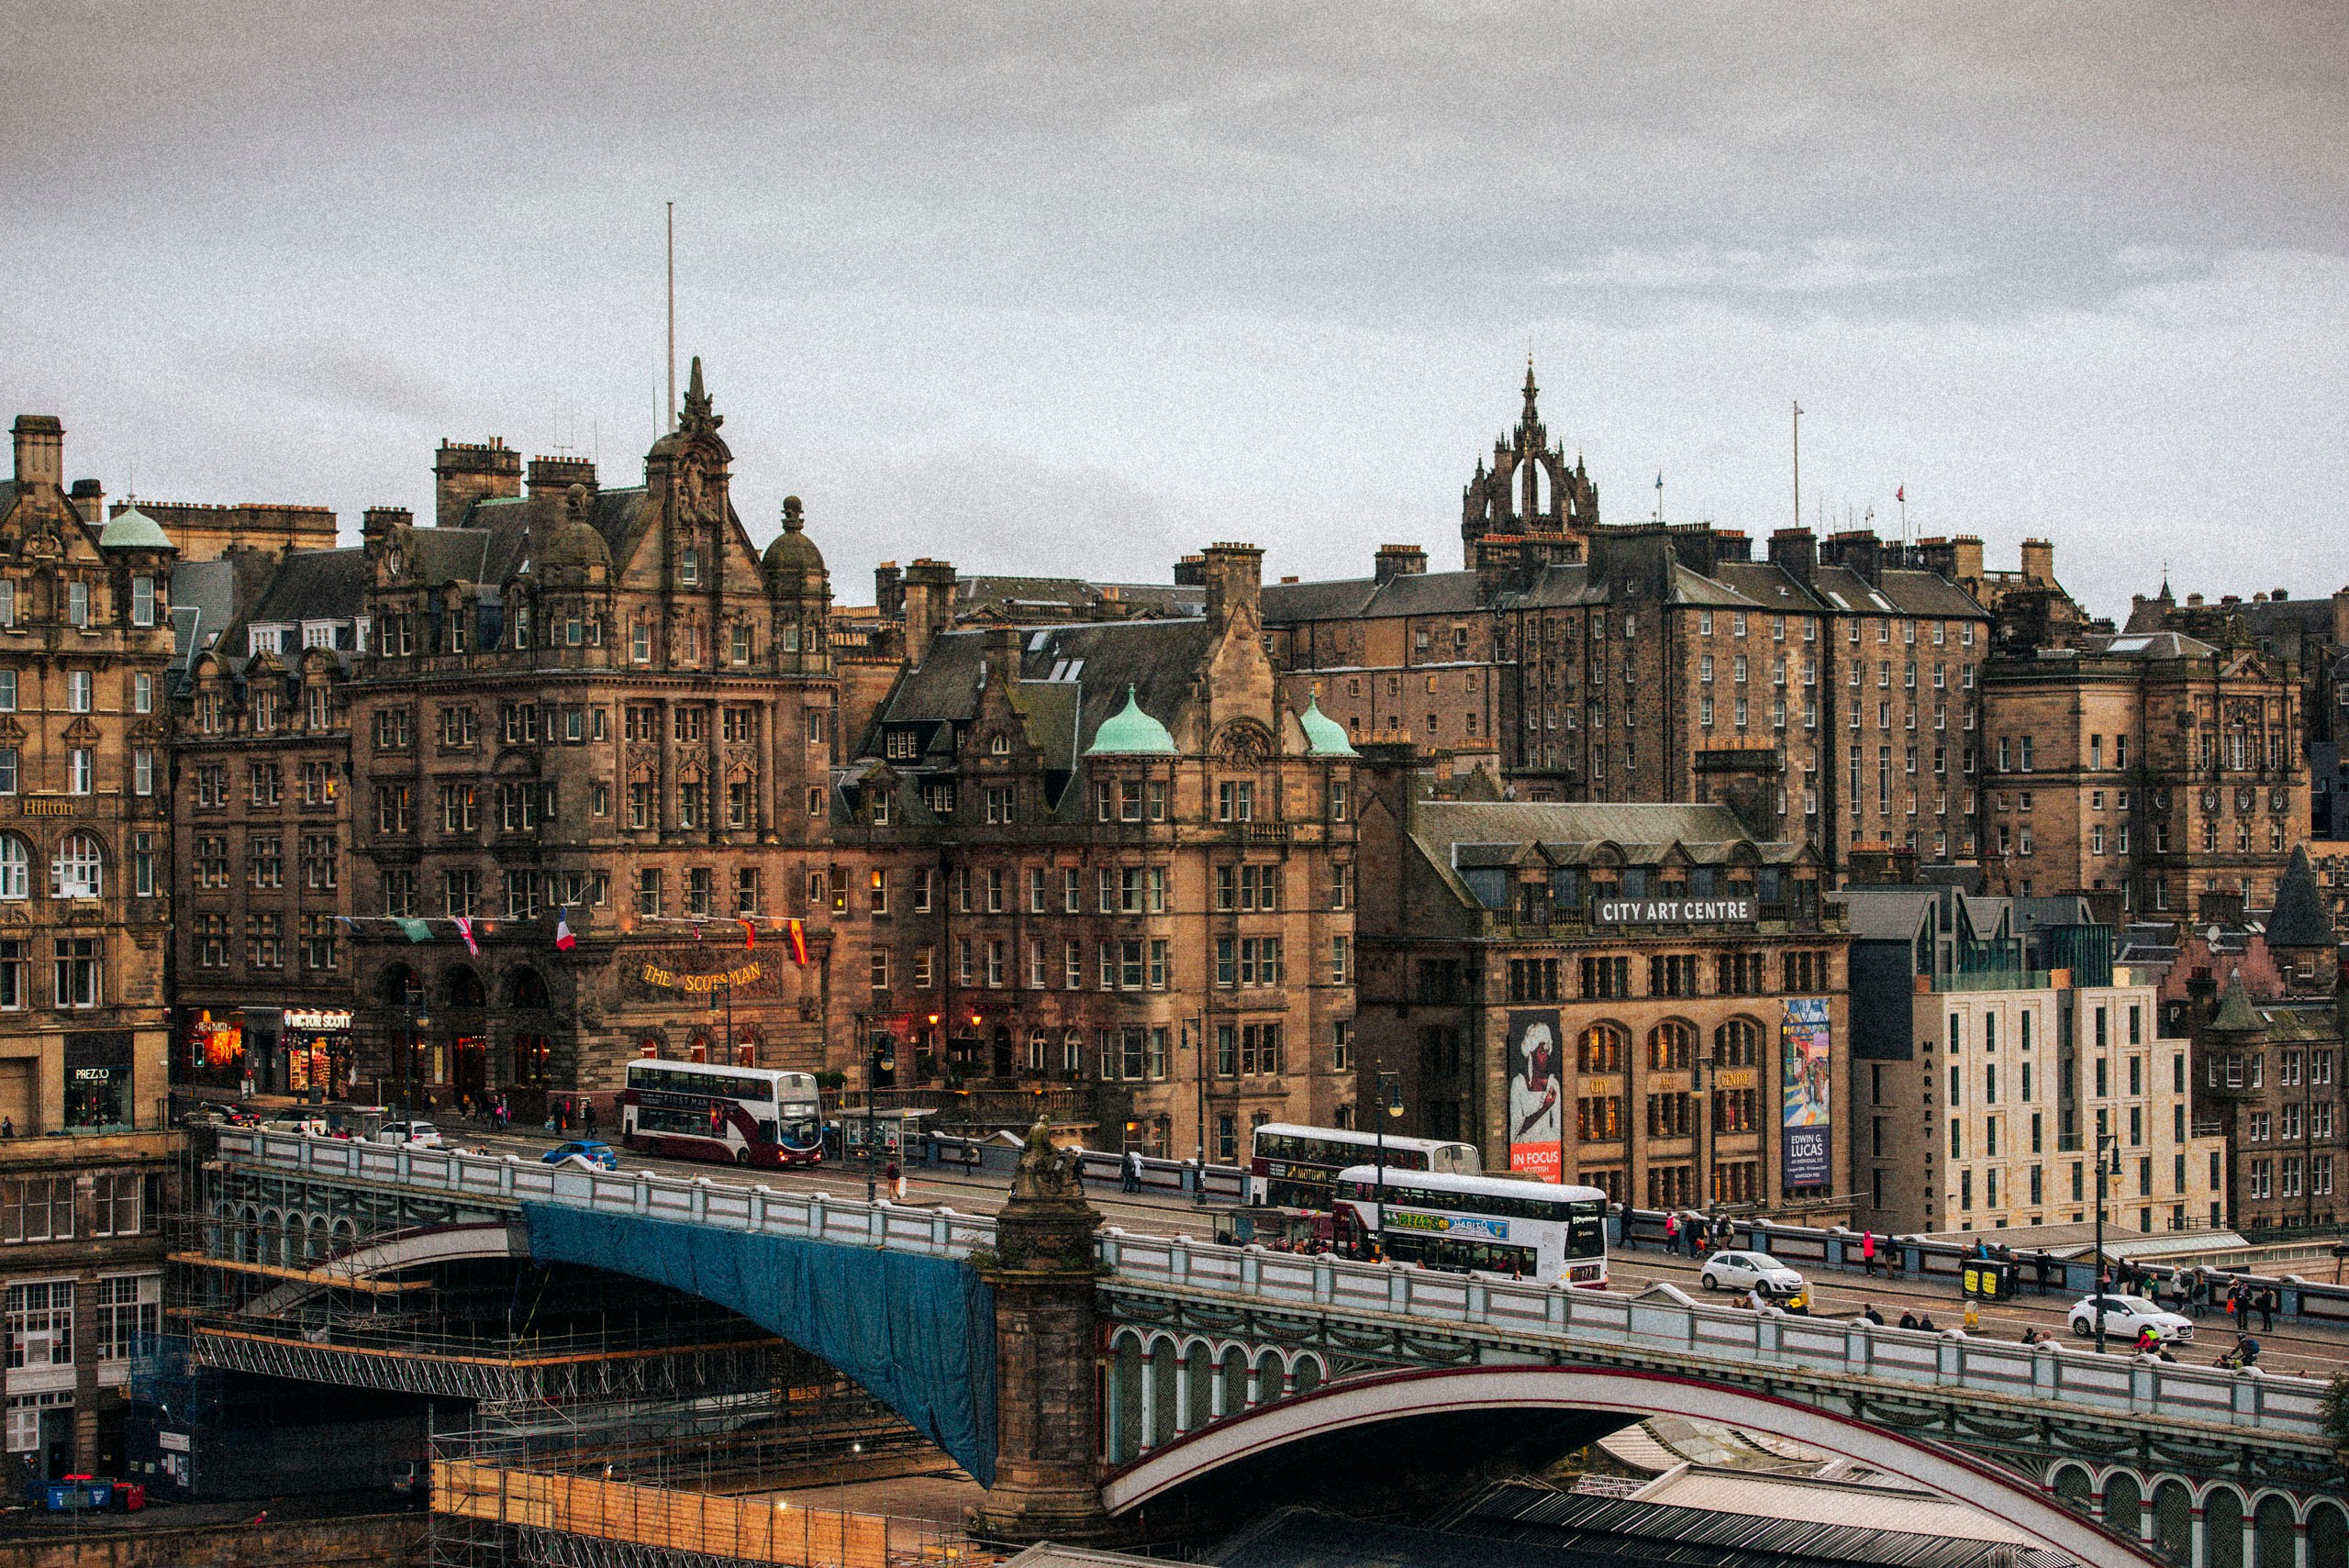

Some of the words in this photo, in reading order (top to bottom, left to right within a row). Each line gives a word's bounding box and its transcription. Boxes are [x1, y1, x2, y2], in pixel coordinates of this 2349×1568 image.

[24, 799, 73, 815] Hilton
[1602, 903, 1641, 921] CITY
[1647, 902, 1678, 920] ART
[1684, 901, 1748, 919] CENTRE
[644, 964, 672, 987] THE
[685, 962, 761, 992] SCOTSMAN
[291, 1014, 322, 1028] VICTOR
[322, 1014, 351, 1028] SCOTT
[1590, 1079, 1608, 1094] CITY
[1660, 1075, 1676, 1090] ART
[1720, 1073, 1750, 1086] CENTRE
[1922, 1041, 1933, 1139] MARKET
[664, 1095, 689, 1106] FIRST
[691, 1097, 708, 1106] MAN
[1791, 1135, 1814, 1144] EDWIN
[1815, 1134, 1823, 1143] G.
[1791, 1143, 1823, 1157] LUCAS
[1513, 1153, 1524, 1165] IN
[1527, 1151, 1559, 1165] FOCUS
[1297, 1167, 1327, 1181] MOTOWN
[1924, 1152, 1933, 1233] STREE
[1454, 1219, 1487, 1230] HABITO
